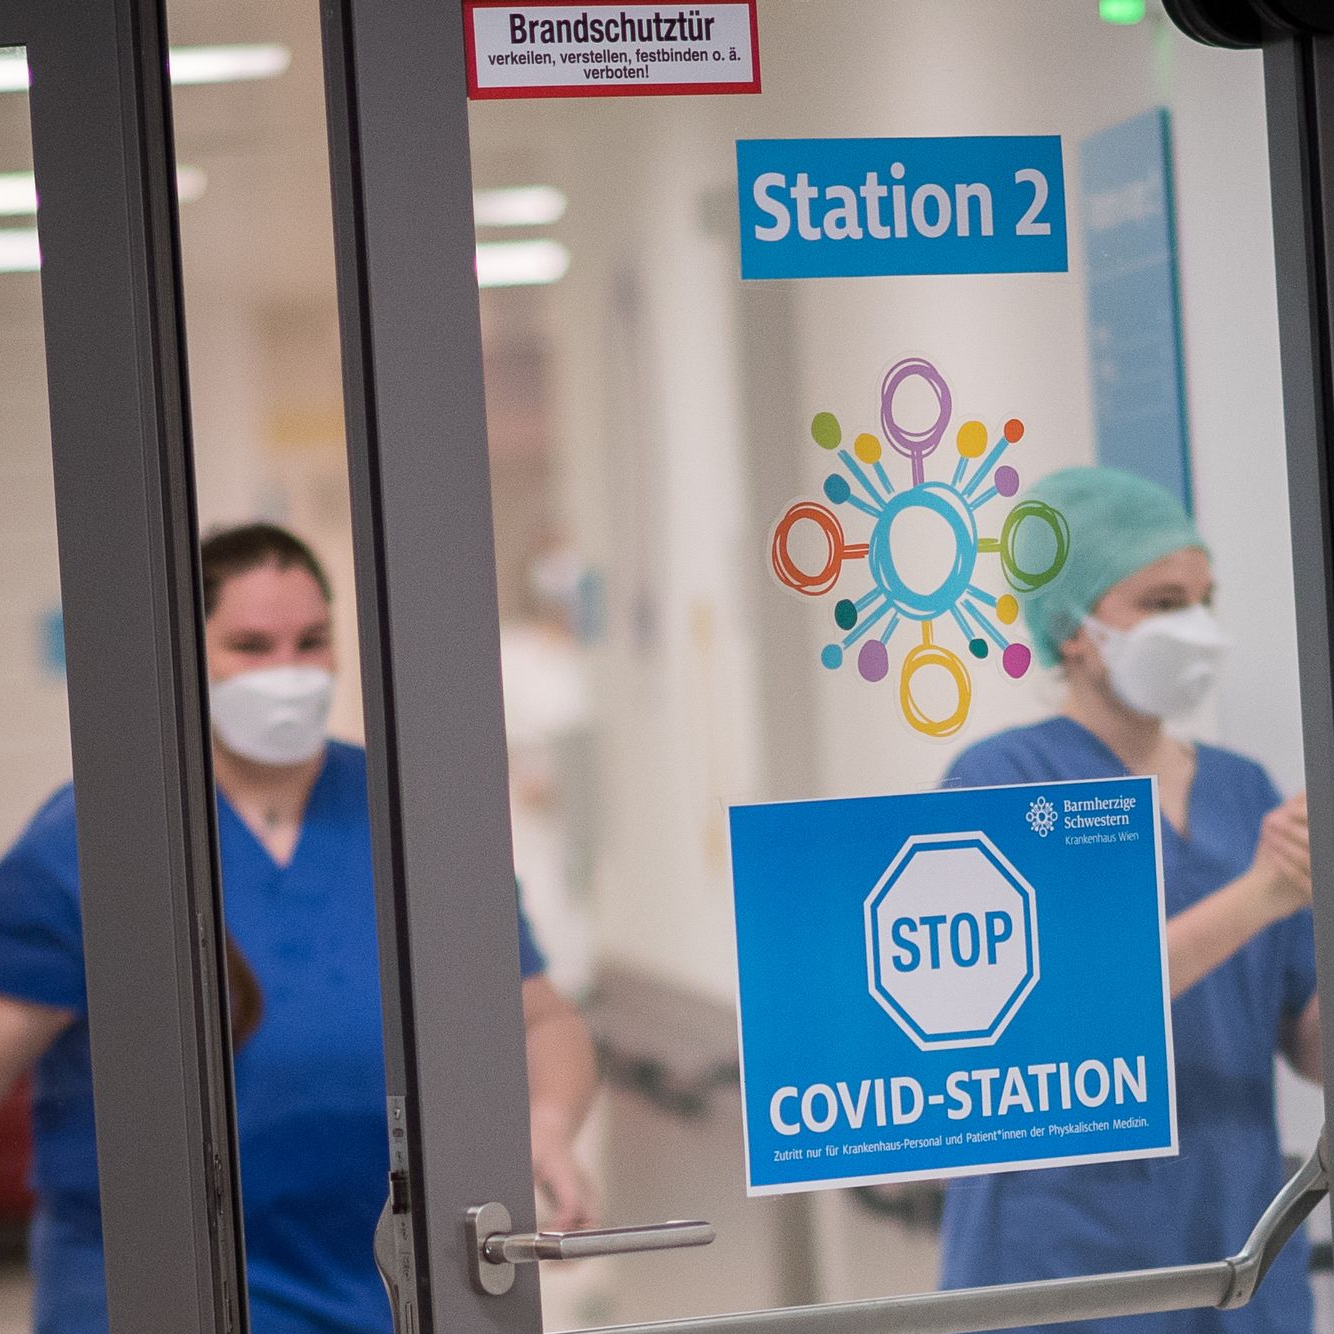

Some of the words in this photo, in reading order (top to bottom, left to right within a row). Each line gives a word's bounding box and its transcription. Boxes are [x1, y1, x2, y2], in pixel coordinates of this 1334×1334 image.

[508, 10, 715, 44] Brandschutztür
[487, 49, 556, 67] verkeilen,
[560, 49, 632, 66] verstellen,
[635, 48, 709, 63] festbinden
[712, 51, 725, 62] o.
[728, 47, 742, 61] ä.
[583, 64, 649, 80] verboten!
[752, 162, 994, 242] Station
[1014, 168, 1052, 236] 2
[1063, 795, 1137, 812] Barmherzige
[1064, 814, 1130, 829] Schwestern
[1065, 831, 1117, 845] Krankenhaus
[1118, 830, 1140, 842] Wien
[891, 910, 1013, 973] STOP
[769, 1055, 1148, 1136] COVID-STATION
[773, 1148, 803, 1162] Zutritt
[806, 1148, 822, 1159] nur
[825, 1145, 839, 1157] für
[842, 1135, 942, 1155] Krankenhaus-Personal
[945, 1133, 963, 1145] und
[1030, 1126, 1045, 1137] der
[1048, 1121, 1109, 1137] Physkalischen
[1112, 1116, 1149, 1130] Medizin.
